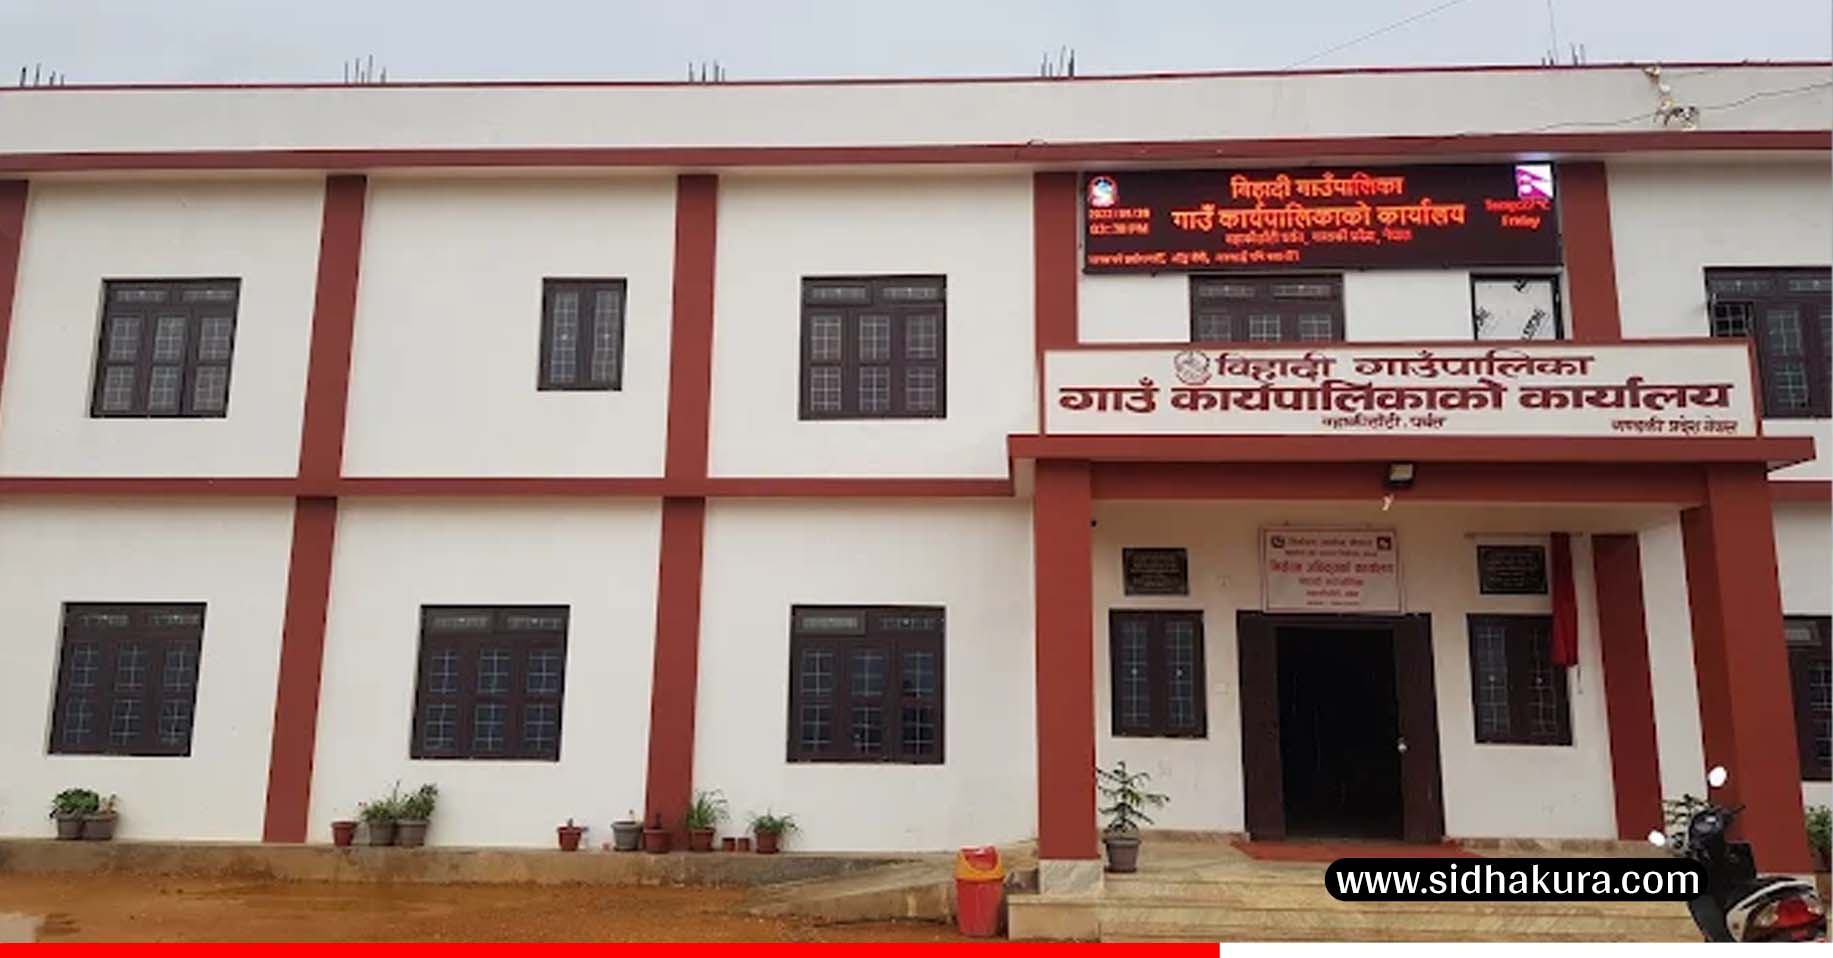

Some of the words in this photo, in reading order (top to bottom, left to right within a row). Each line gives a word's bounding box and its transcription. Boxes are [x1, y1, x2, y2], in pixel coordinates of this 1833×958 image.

[1171, 203, 1215, 231] गाउँ
[1217, 200, 1371, 229] कार्यपालिकाको
[1376, 198, 1466, 226] कार्यालय
[1353, 350, 1594, 378] गाउँपालिका
[1059, 377, 1160, 413] गाउँ
[1170, 378, 1508, 412] कार्यपालिकाको
[1518, 377, 1734, 411] कार्यालय
